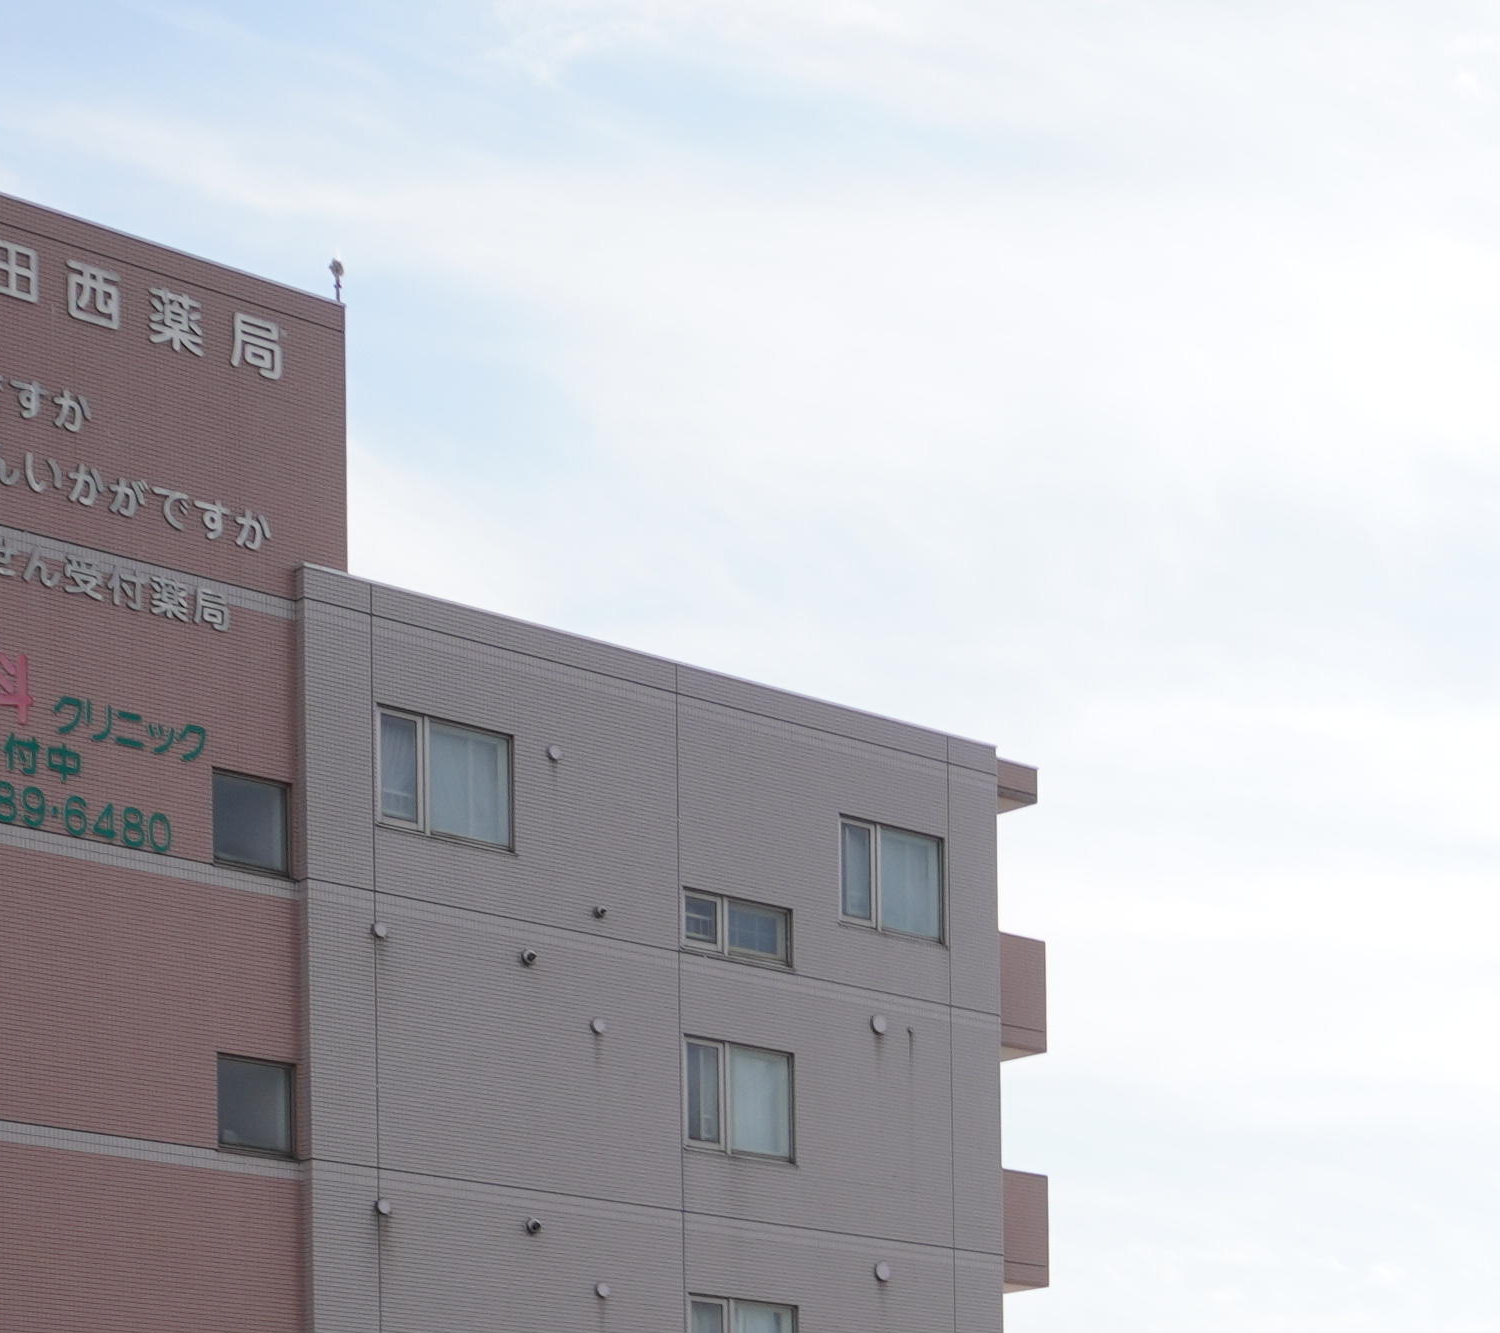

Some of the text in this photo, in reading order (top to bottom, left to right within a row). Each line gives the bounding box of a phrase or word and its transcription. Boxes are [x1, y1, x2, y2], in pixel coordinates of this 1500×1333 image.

[52, 696, 208, 763] クリニック
